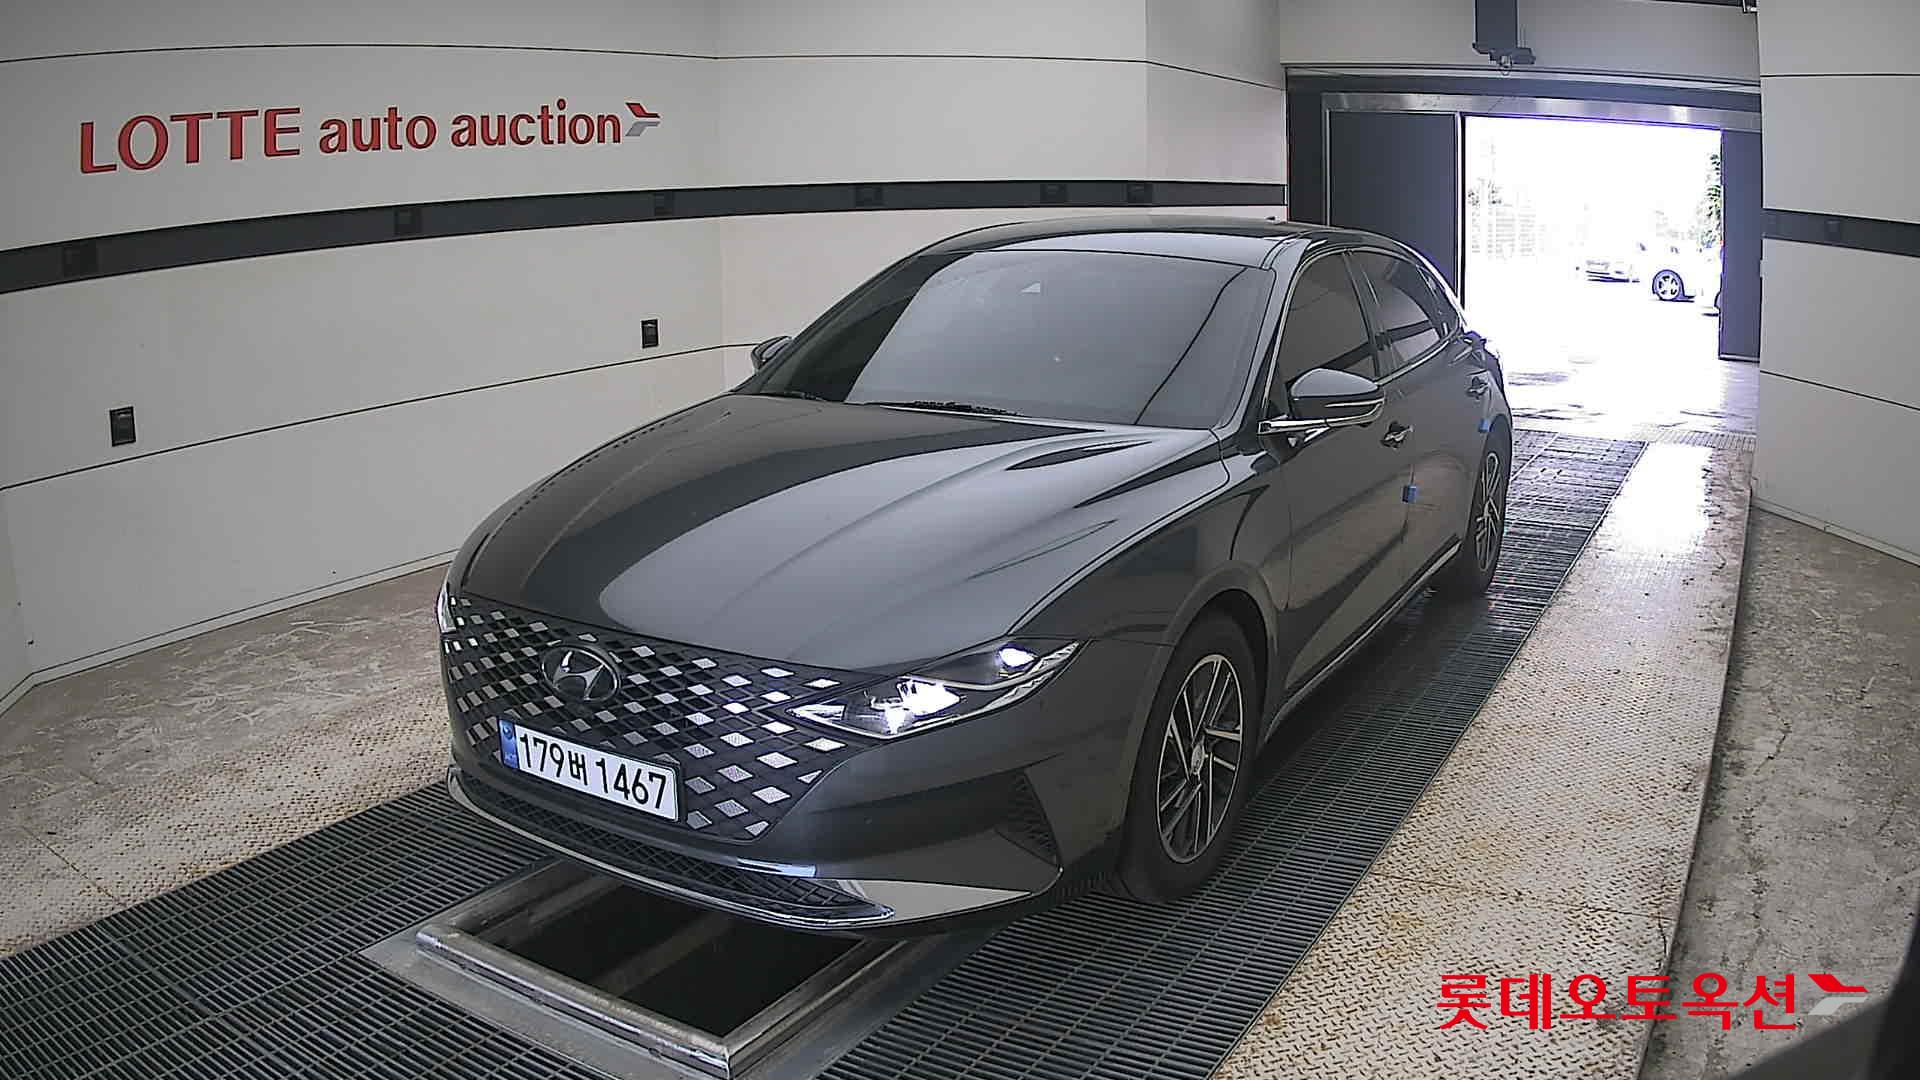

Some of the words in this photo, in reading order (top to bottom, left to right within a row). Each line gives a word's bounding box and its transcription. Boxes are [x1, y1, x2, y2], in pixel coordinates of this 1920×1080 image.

[80, 107, 301, 174] LOTTE
[319, 107, 438, 154] auto
[451, 98, 622, 148] auction
[519, 733, 588, 786] 179버
[596, 757, 667, 809] 1467
